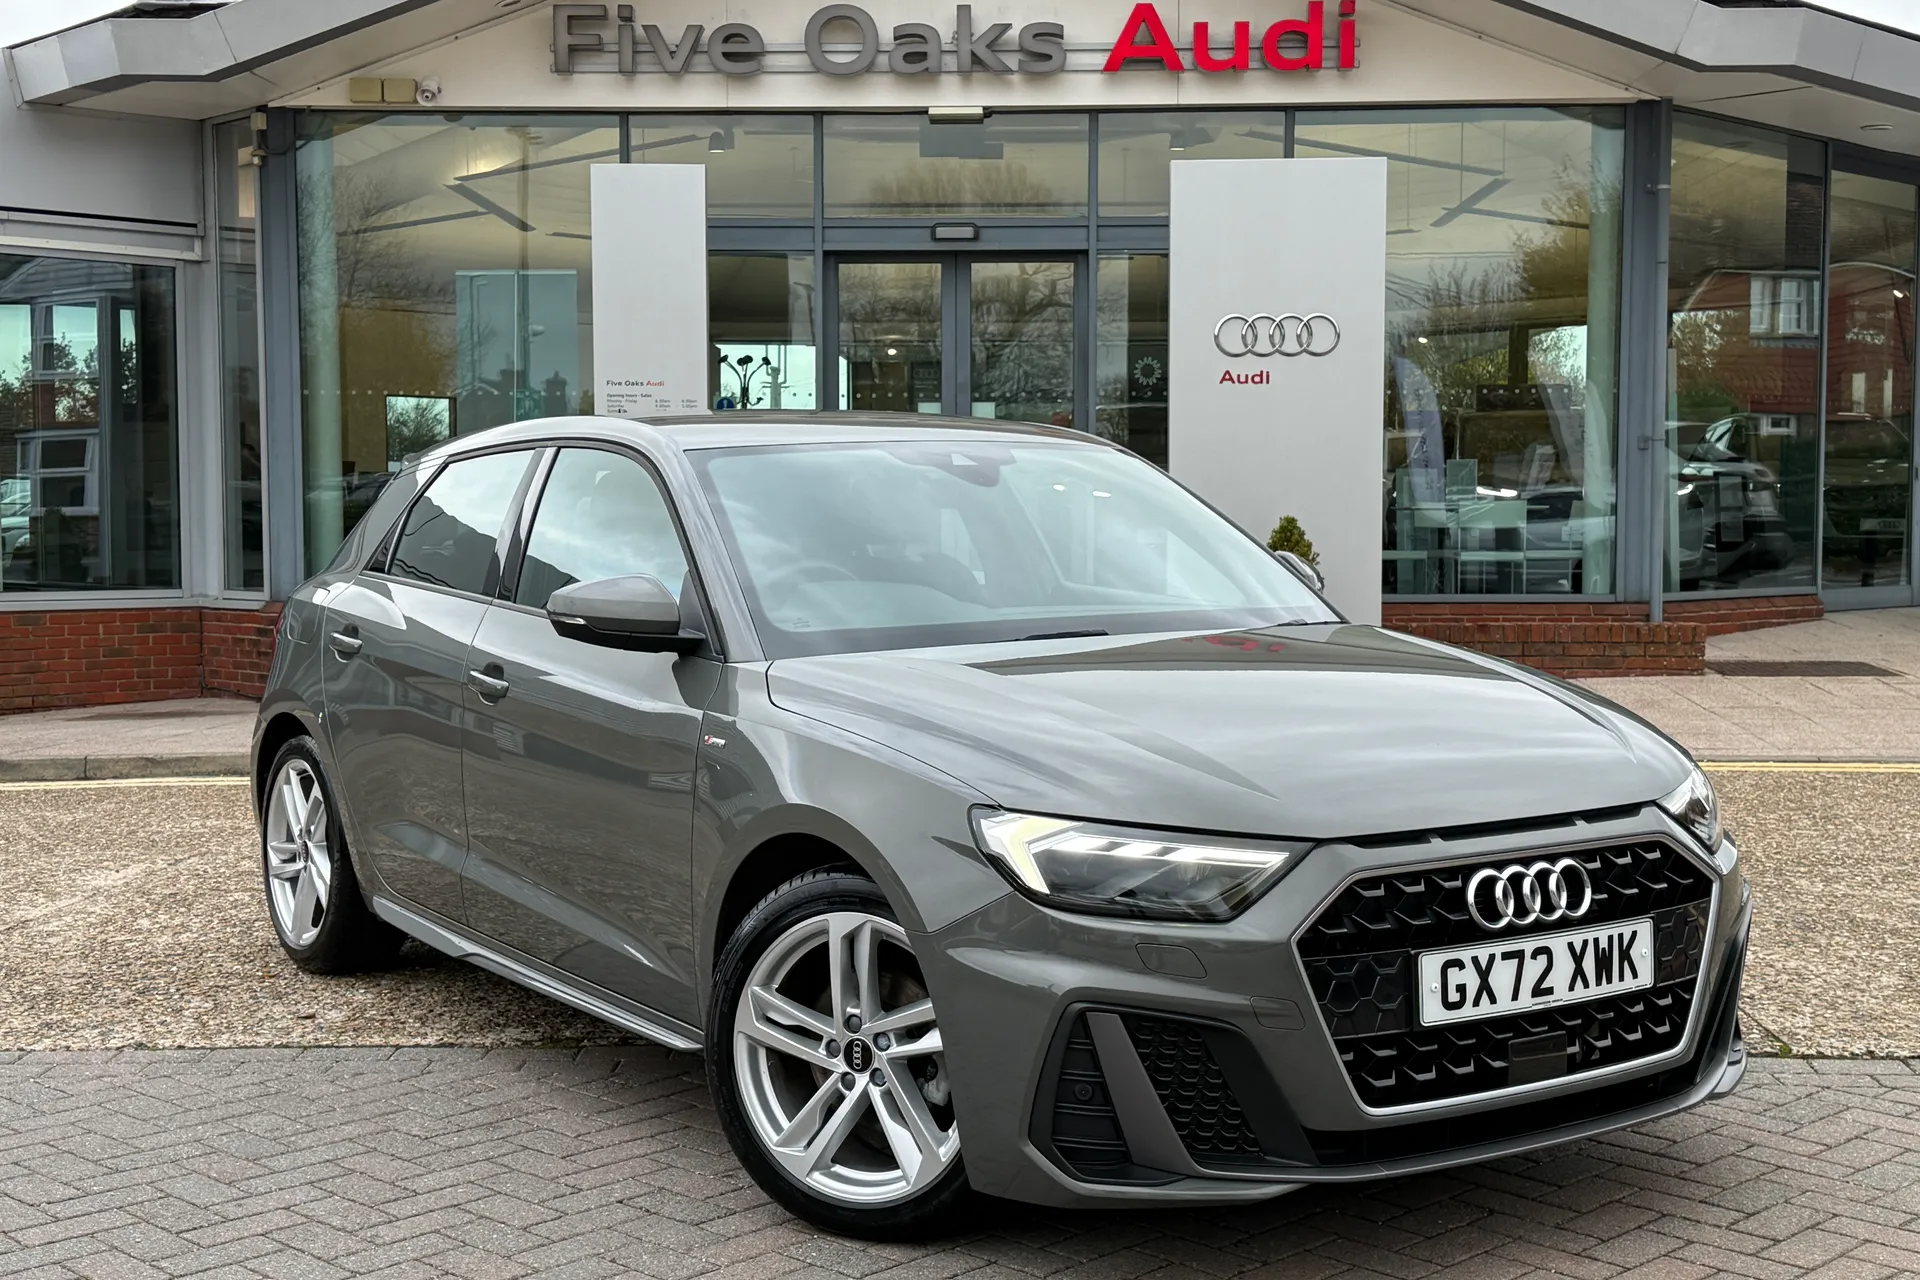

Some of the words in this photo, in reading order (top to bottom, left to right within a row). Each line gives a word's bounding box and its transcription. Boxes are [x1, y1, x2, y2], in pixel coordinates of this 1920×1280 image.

[552, 3, 767, 75] Five
[803, 3, 1068, 76] Oaks
[1102, 0, 1356, 73] Audi
[1218, 369, 1271, 385] Audi
[1440, 945, 1555, 1012] GX72
[1566, 929, 1639, 993] XWK
